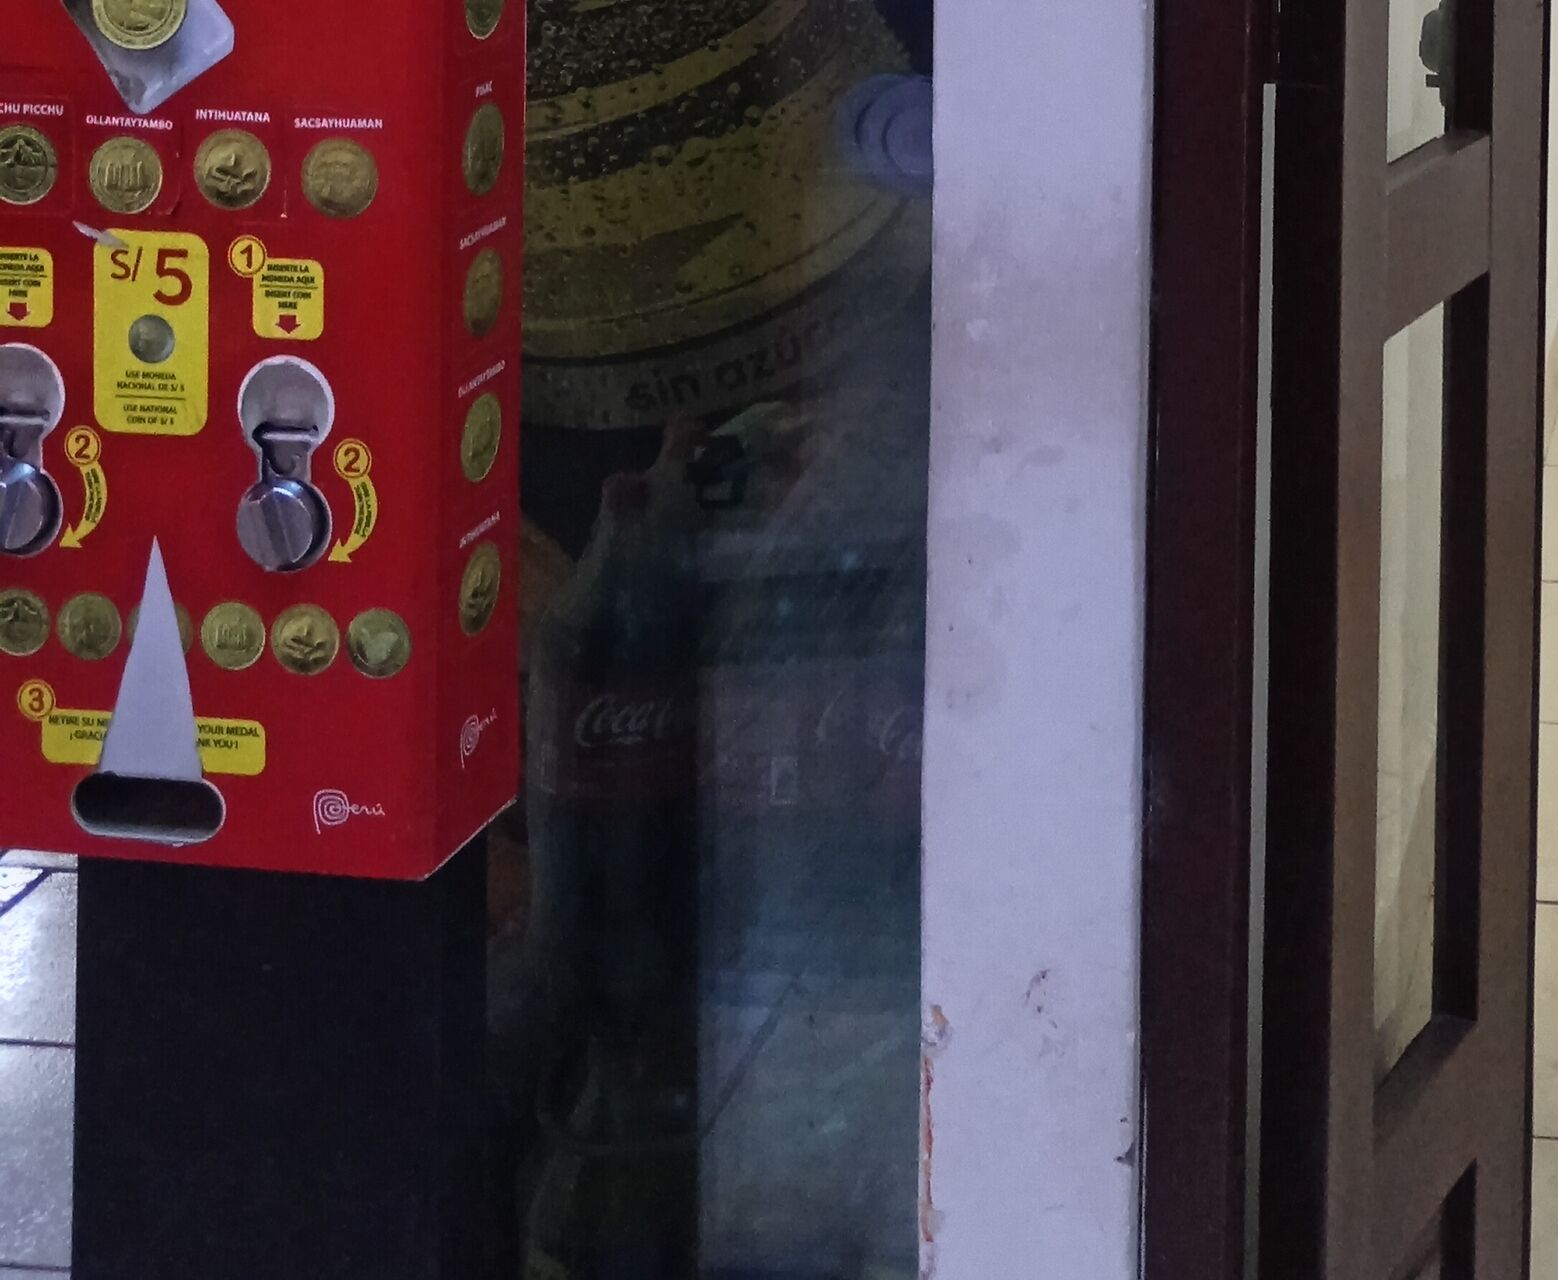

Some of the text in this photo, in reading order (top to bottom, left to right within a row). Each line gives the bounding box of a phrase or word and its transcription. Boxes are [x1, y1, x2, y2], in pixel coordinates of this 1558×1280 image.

[23, 103, 64, 117] PICCHU
[195, 109, 271, 123] INTIHUATANA
[86, 114, 174, 130] OLLANTAYTAMBO
[294, 117, 383, 129] SACSAYHUAMAN
[240, 244, 253, 270] 1
[110, 246, 193, 306] S/ 5
[75, 434, 90, 459] 2
[344, 447, 360, 473] 2
[27, 687, 45, 712] 3
[226, 726, 260, 737] MEDAL
